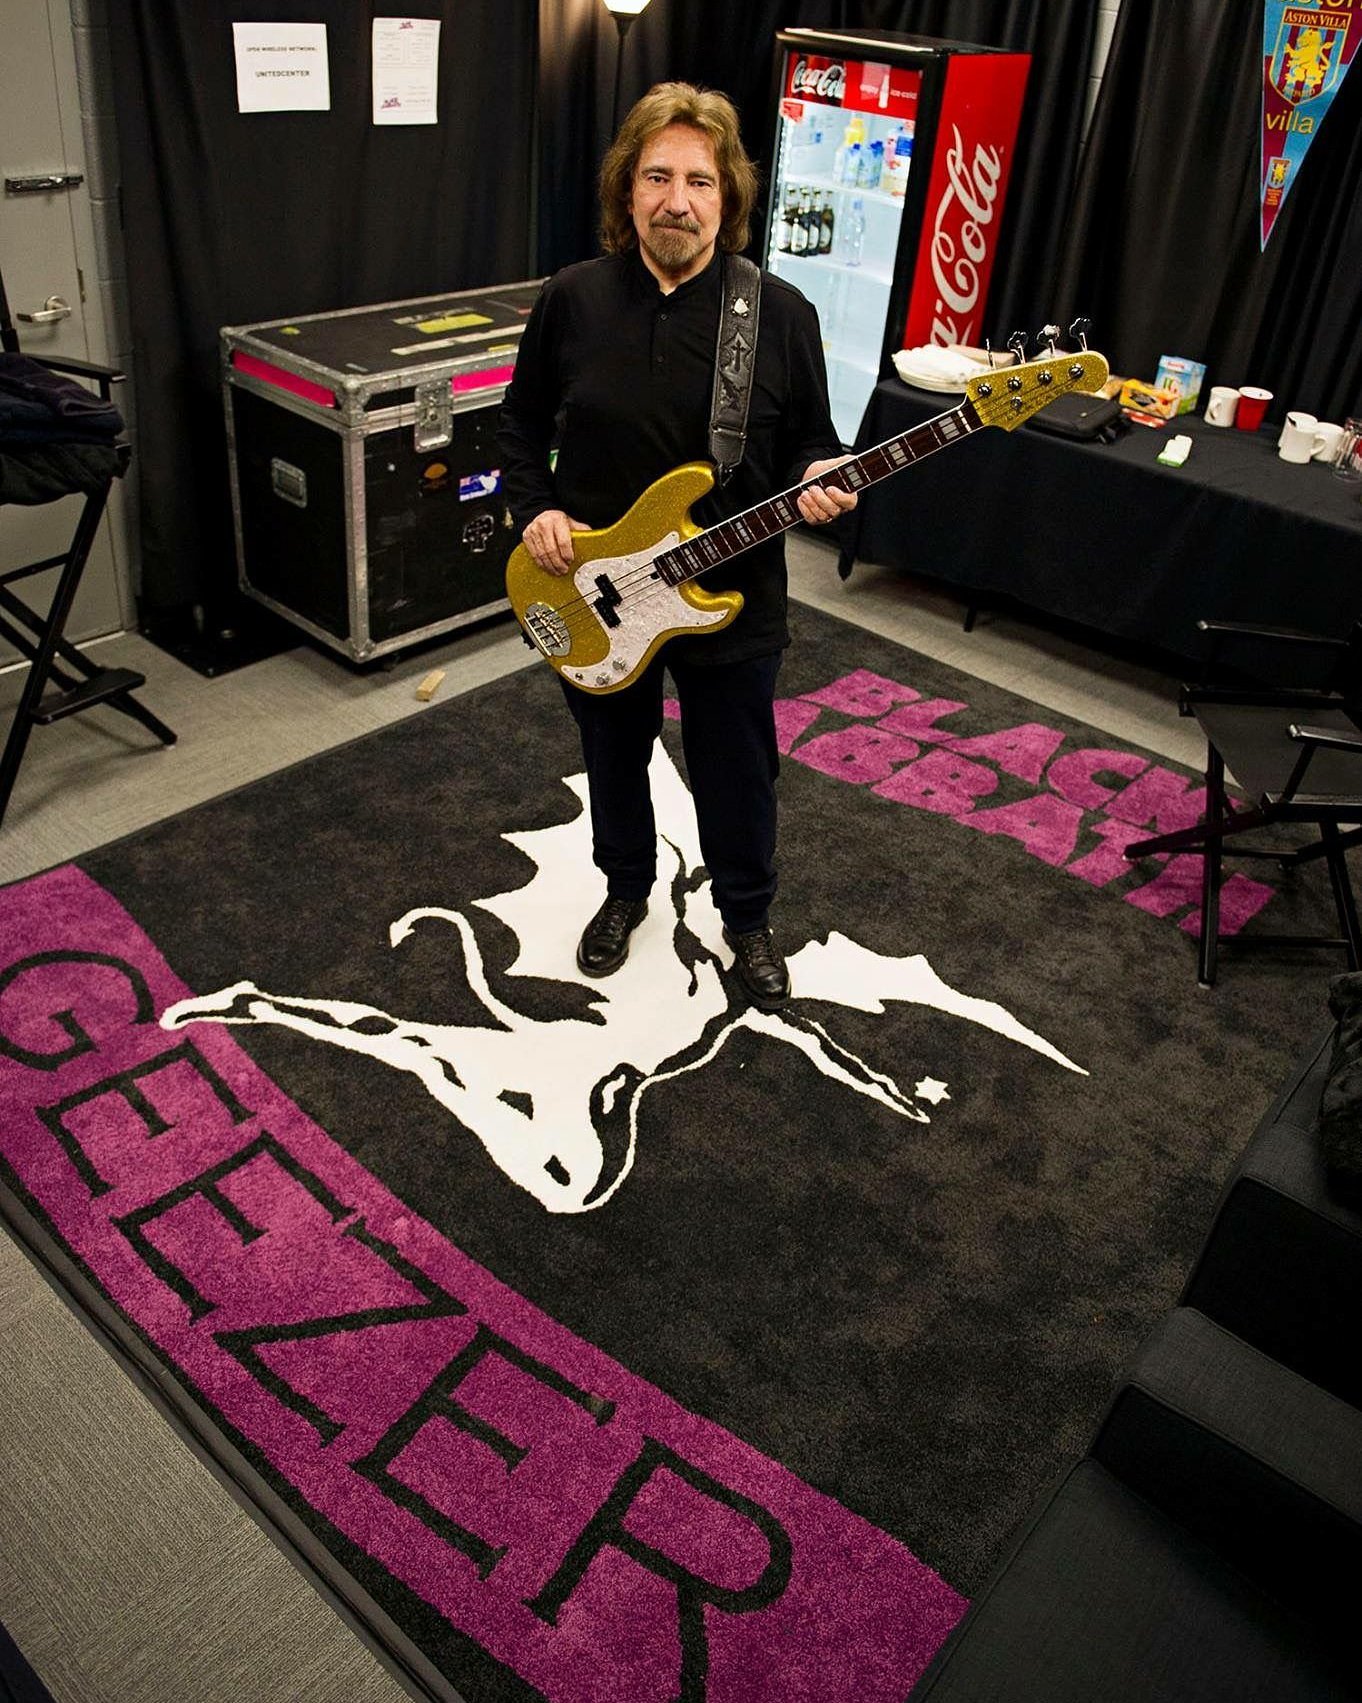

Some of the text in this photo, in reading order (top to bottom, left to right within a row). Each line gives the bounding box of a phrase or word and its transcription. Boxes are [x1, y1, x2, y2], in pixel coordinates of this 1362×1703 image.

[1285, 11, 1347, 28] ASTON VILLA
[1266, 110, 1315, 134] villa
[0, 950, 793, 1703] GEEZER
